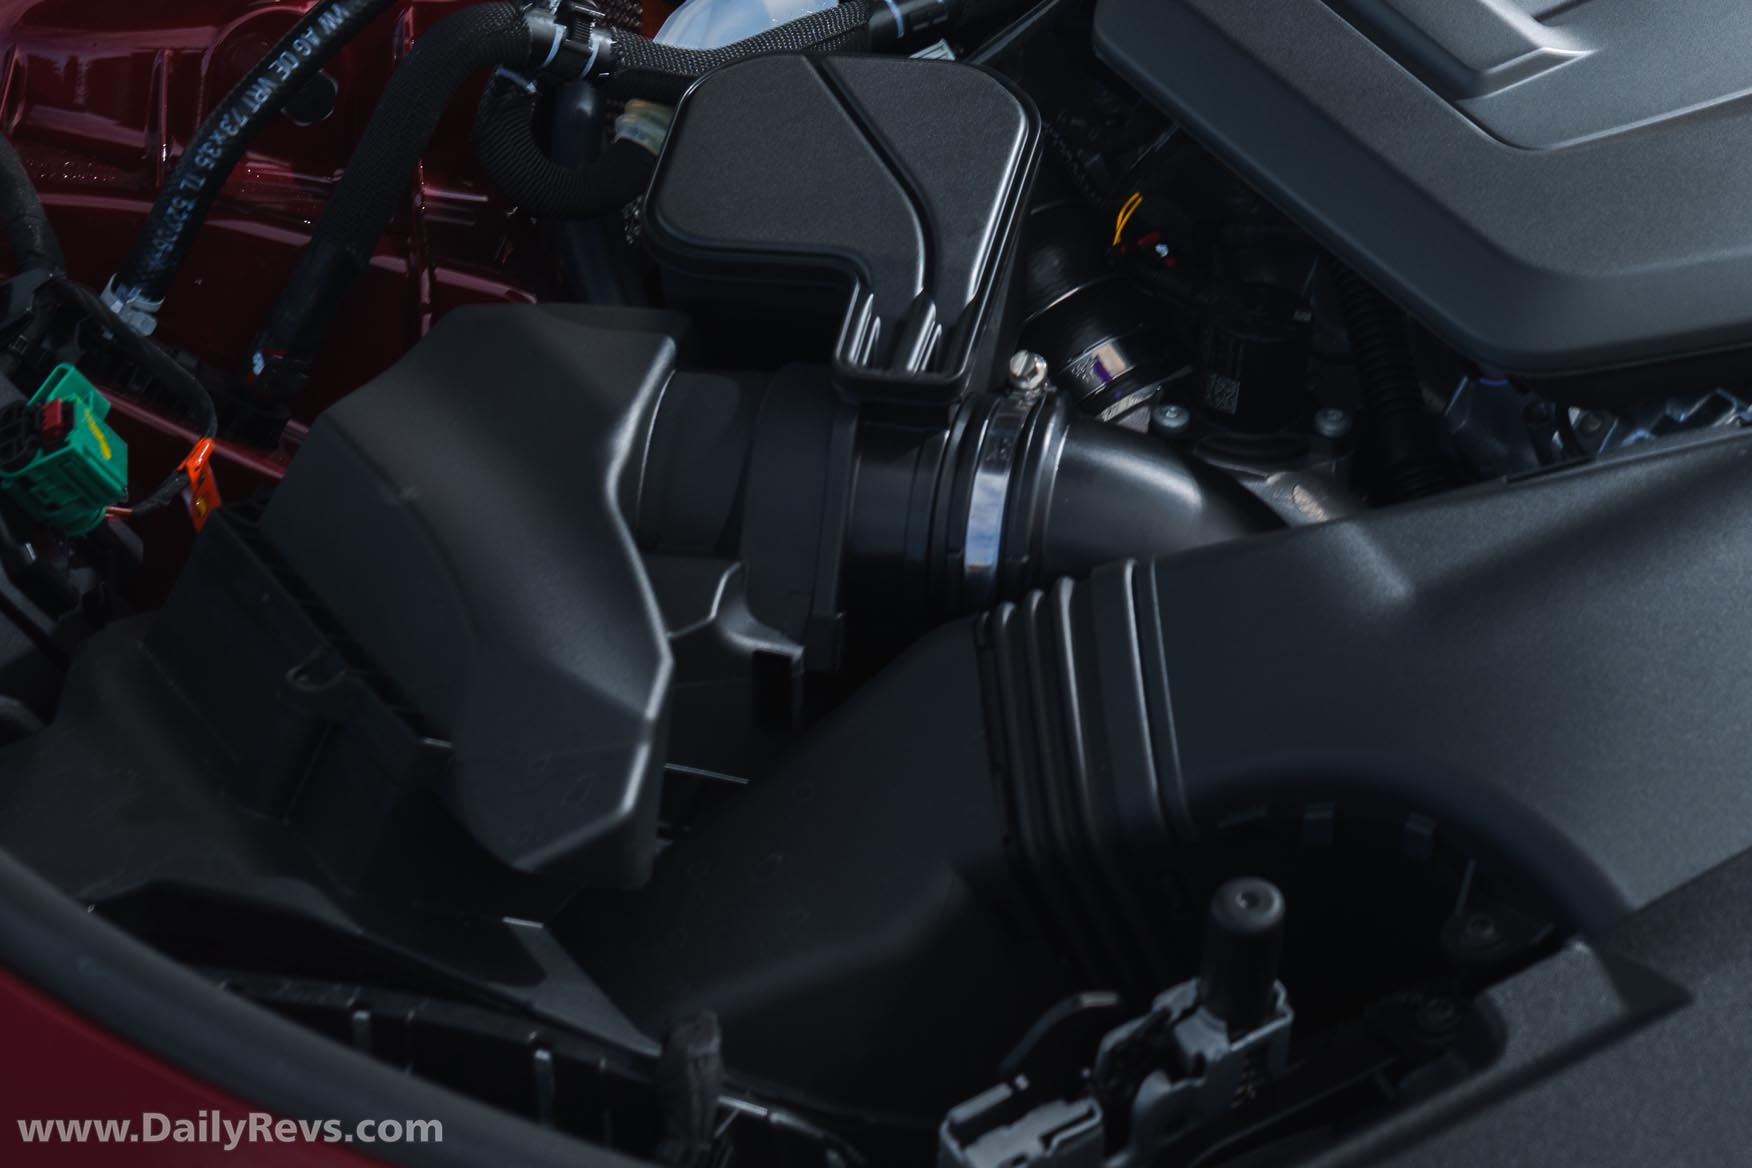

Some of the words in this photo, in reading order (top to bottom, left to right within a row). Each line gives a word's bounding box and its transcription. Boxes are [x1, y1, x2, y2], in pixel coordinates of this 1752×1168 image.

[317, 2, 350, 34] VW
[293, 25, 321, 56] AG
[267, 50, 300, 81] DE
